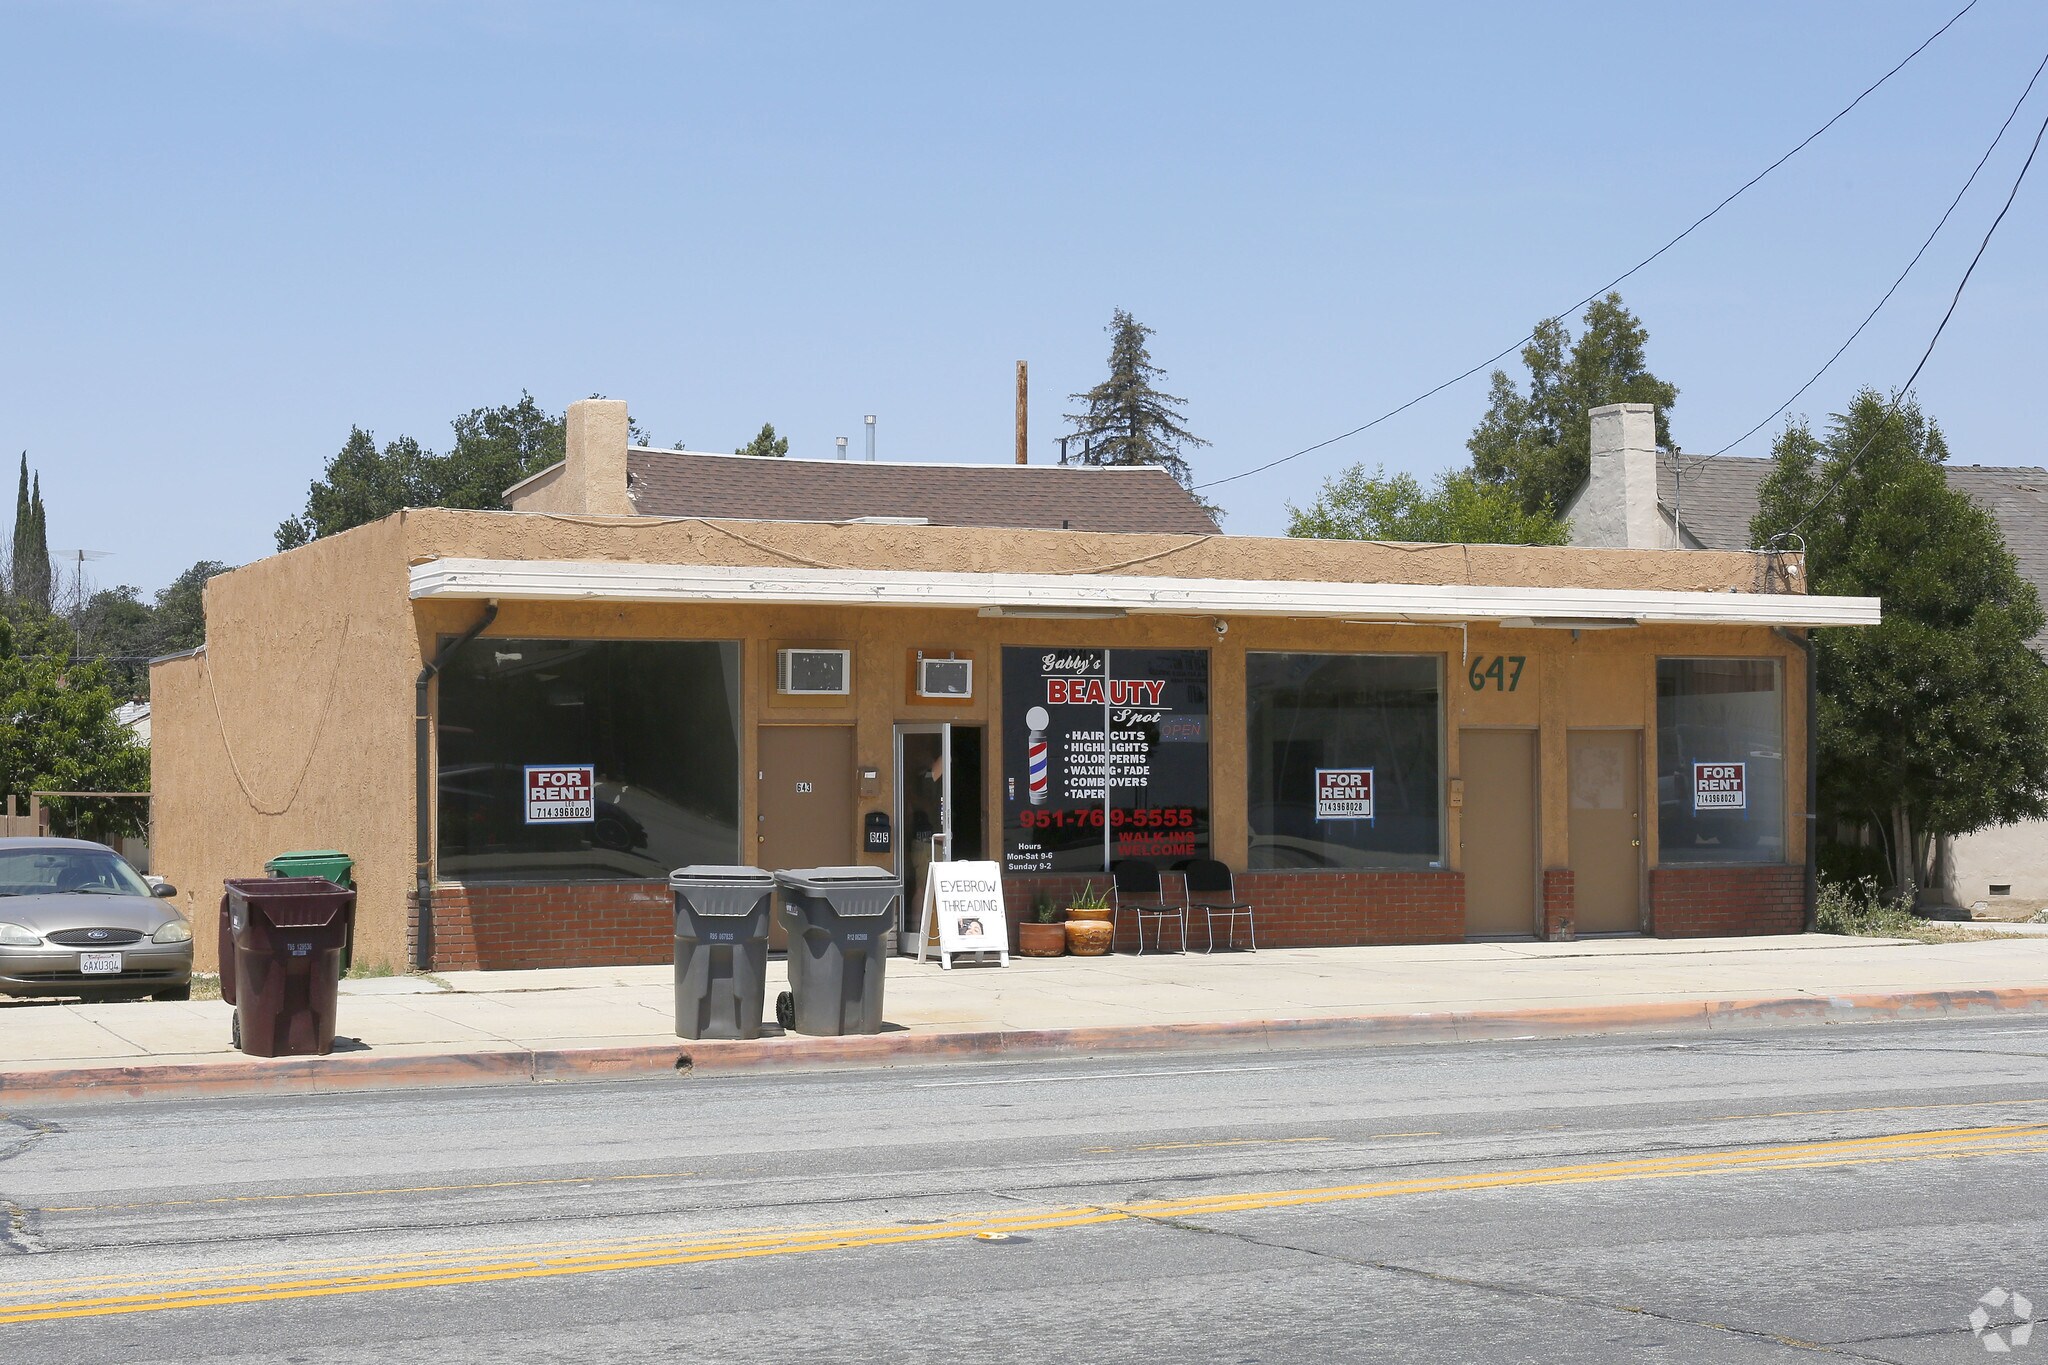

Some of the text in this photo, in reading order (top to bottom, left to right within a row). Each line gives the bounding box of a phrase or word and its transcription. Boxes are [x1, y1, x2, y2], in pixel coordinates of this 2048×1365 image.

[1041, 653, 1101, 674] Gabby's
[1468, 655, 1527, 692] 647
[1047, 679, 1166, 705] BEAUTY
[1112, 709, 1162, 727] Spot
[1072, 731, 1146, 741] HAIR CUTS
[1161, 724, 1201, 736] OPEN
[1071, 743, 1149, 752] HIGHLIGHTS
[1070, 754, 1147, 764] COLOR PERMS
[1071, 766, 1150, 775] WAXING FADE
[1703, 767, 1735, 779] FOR
[538, 772, 582, 786] FOR
[1326, 774, 1362, 786] FOR
[1698, 779, 1741, 790] RENT
[796, 782, 812, 792] 643
[1321, 787, 1368, 799] RENT
[531, 787, 589, 800] RENT
[1070, 789, 1106, 799] TAPER
[1020, 809, 1193, 828] 951-769-5555
[869, 832, 889, 843] 645
[1118, 831, 1196, 843] WALK-INS
[1041, 852, 1053, 860] 9-6
[1118, 844, 1196, 856] WELCOME
[1008, 862, 1052, 871] Sunday 9-2
[940, 880, 996, 893] EYEBROW
[942, 899, 998, 912] THREADING
[83, 960, 119, 971] 6AXU304
